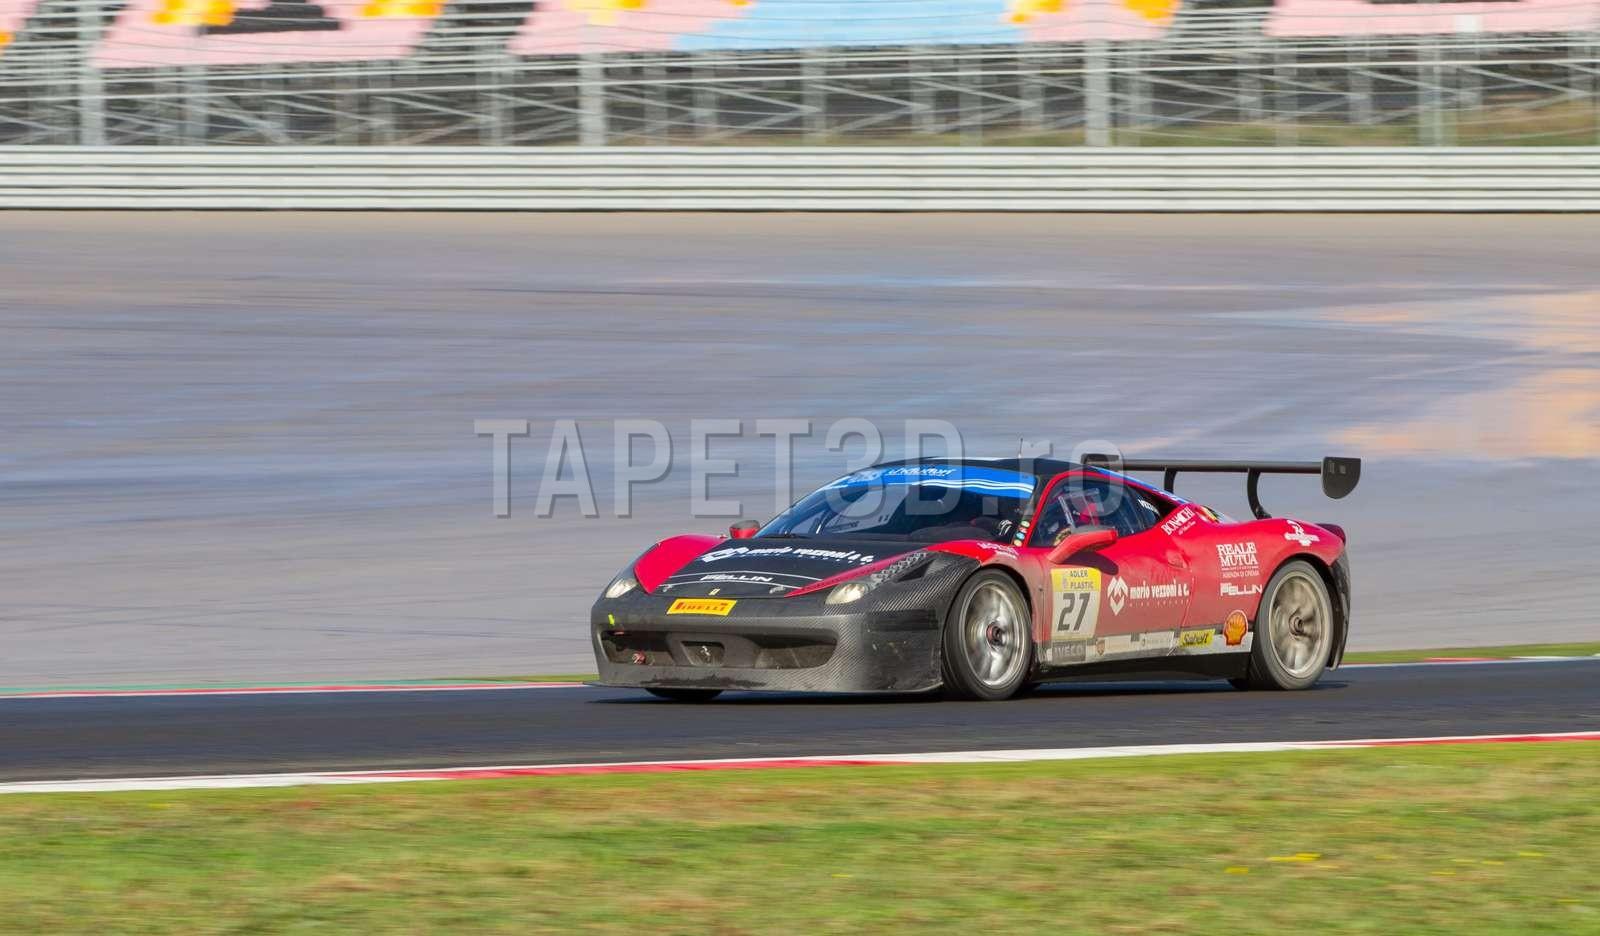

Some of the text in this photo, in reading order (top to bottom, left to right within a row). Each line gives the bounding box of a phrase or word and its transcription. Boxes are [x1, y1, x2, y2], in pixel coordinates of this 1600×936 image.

[1216, 541, 1257, 555] REALE
[1220, 553, 1259, 566] MUTUA
[1070, 569, 1088, 578] ADLER
[1070, 581, 1094, 589] PLASTIC
[1130, 580, 1150, 600] mario
[1151, 579, 1177, 598] vezzoni
[1220, 582, 1263, 596] PELLIN
[1057, 592, 1090, 631] 27
